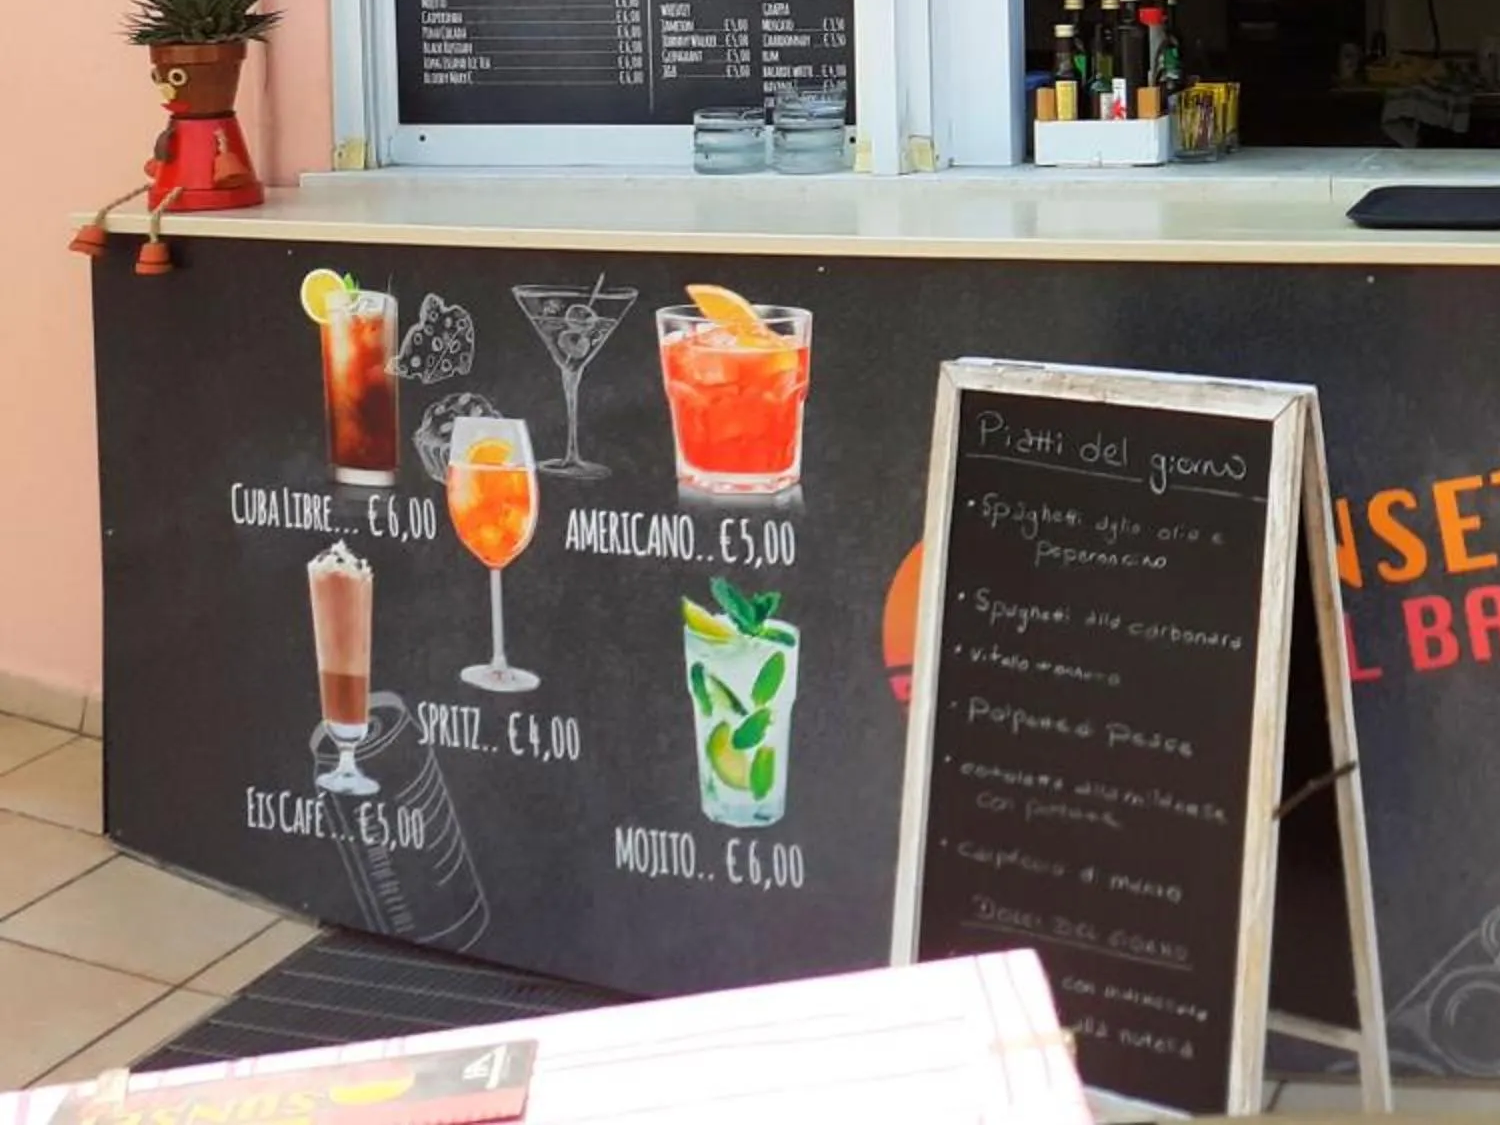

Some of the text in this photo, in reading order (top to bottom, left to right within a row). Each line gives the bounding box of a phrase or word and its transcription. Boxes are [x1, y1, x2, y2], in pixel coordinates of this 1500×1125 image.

[977, 410, 1066, 456] Piatti
[1079, 432, 1129, 468] del
[231, 482, 281, 530] CUBA
[246, 785, 278, 829] EIS
